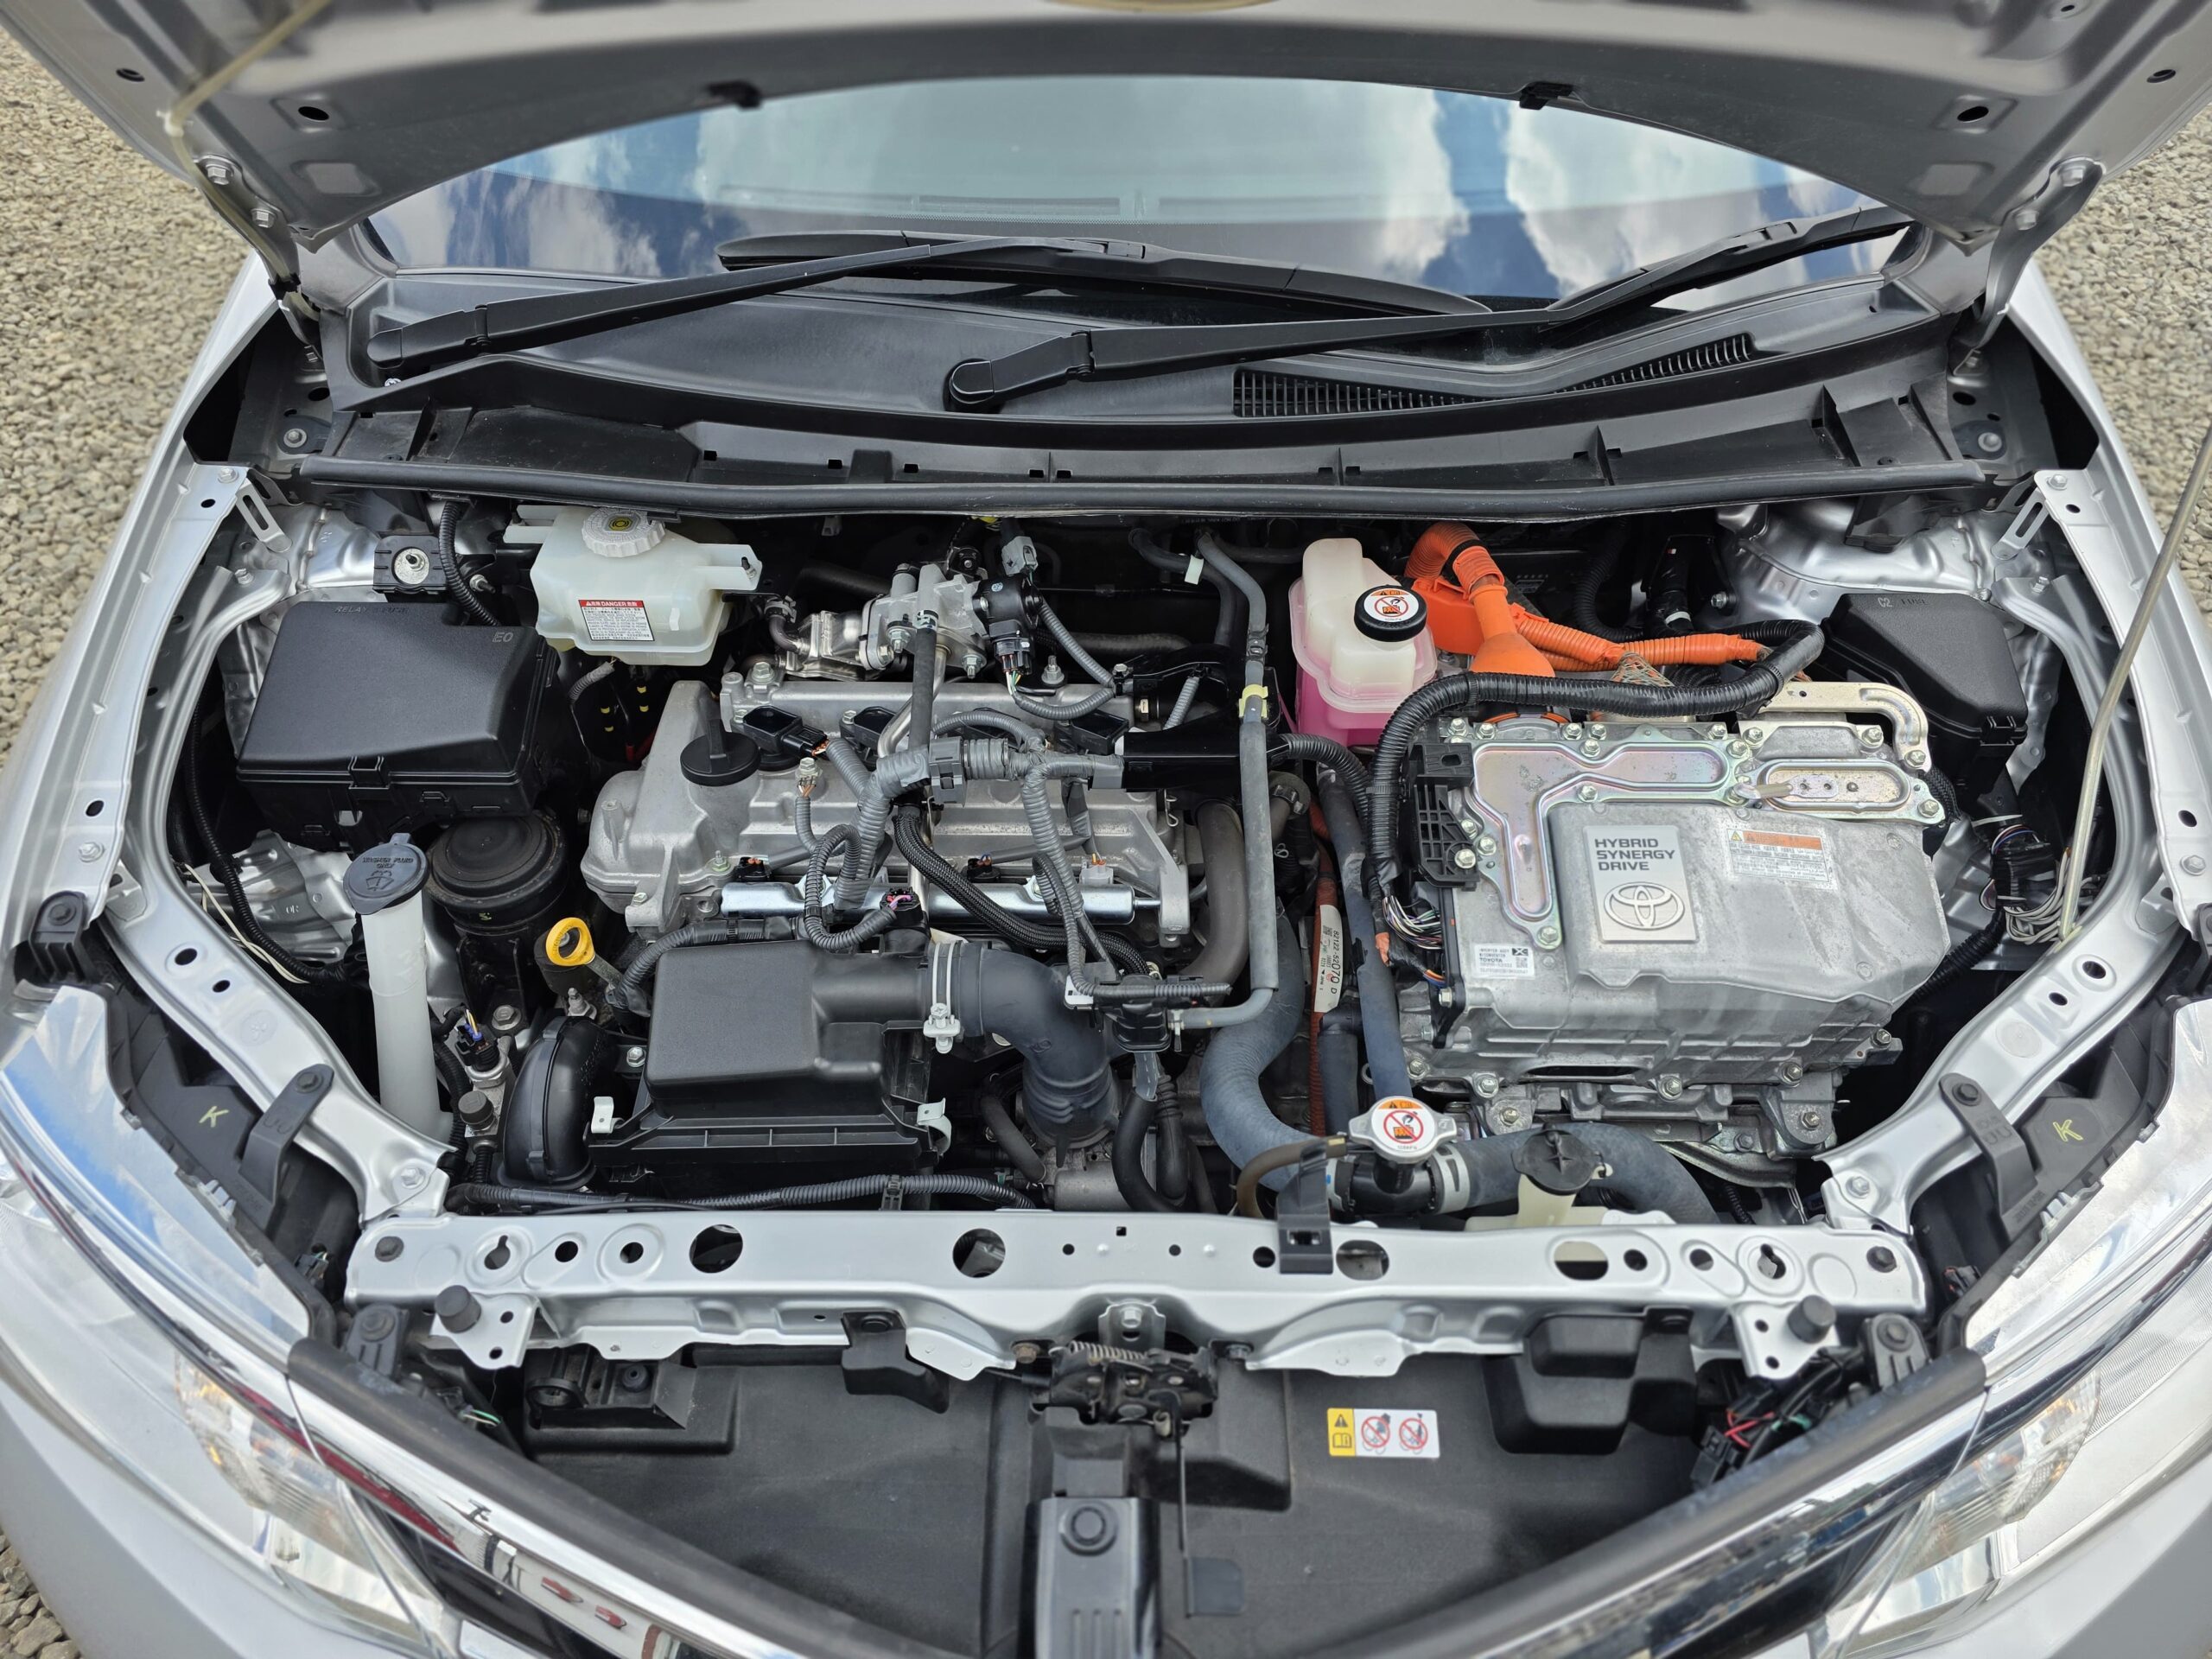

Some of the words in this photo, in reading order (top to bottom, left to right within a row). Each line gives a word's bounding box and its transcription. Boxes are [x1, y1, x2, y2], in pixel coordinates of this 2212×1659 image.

[1594, 838, 1659, 848] HYBRID
[1596, 849, 1675, 860] SYNERGY
[1598, 861, 1649, 871] DRIVE
[199, 1105, 230, 1128] K
[2052, 1119, 2084, 1142] K
